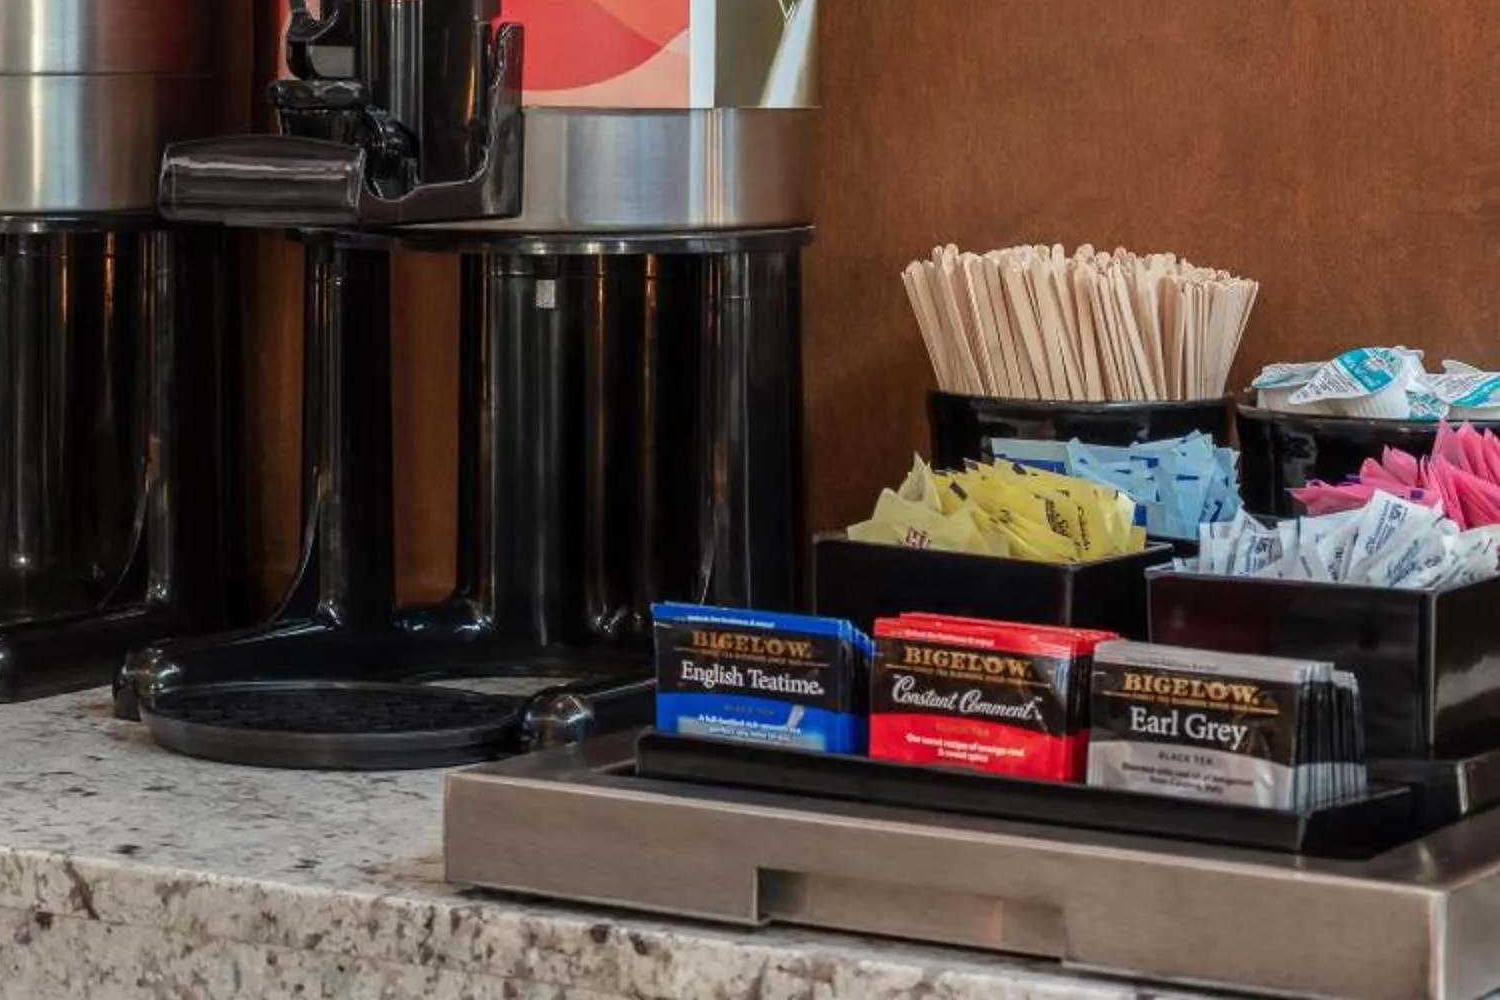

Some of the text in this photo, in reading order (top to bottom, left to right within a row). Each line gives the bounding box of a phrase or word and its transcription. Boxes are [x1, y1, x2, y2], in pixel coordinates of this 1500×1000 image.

[681, 659, 744, 689] English
[1130, 706, 1248, 751] Earl Grey
